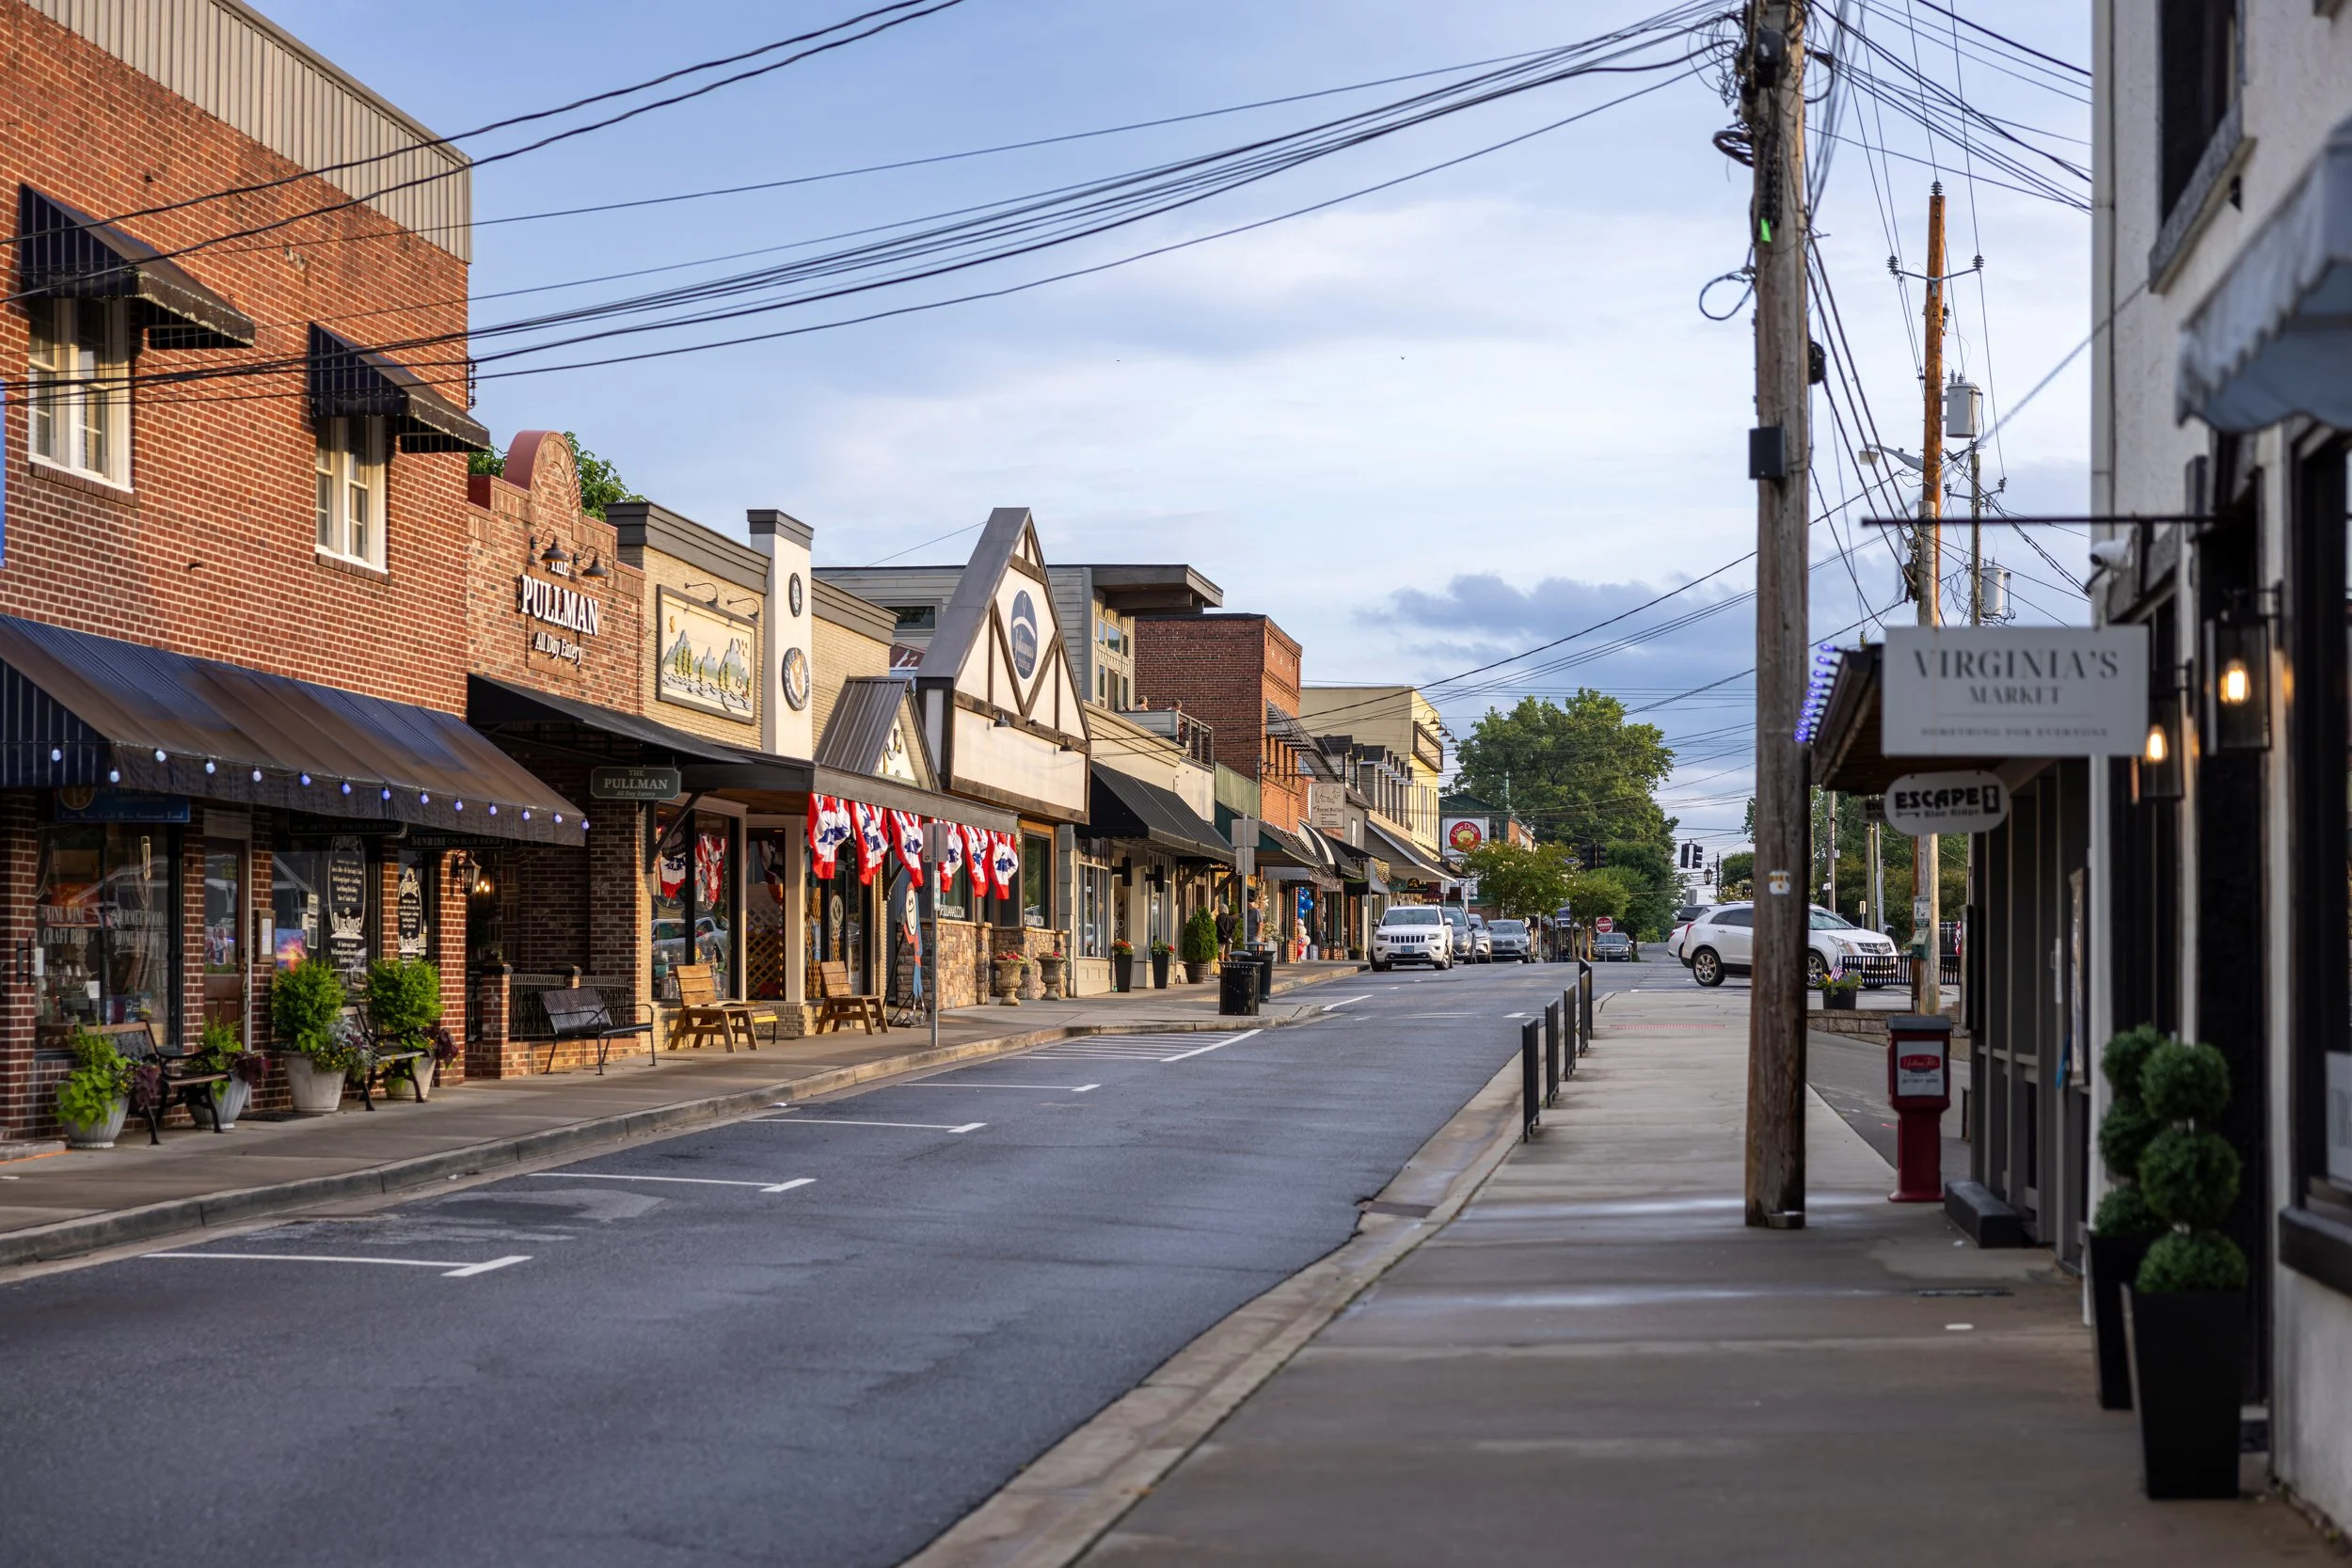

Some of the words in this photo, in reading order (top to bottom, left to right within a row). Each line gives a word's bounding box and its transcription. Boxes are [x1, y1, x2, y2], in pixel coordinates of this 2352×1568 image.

[521, 575, 599, 636] PULLMAN
[535, 632, 547, 651] All
[547, 635, 561, 659] Day
[561, 639, 582, 665] Eatery
[1914, 649, 2119, 679] VIRGINIA'S
[1969, 686, 2062, 705] MARKET
[603, 778, 669, 789] PULLMAN
[1895, 787, 1980, 809] ESCAPE
[1924, 810, 1947, 818] Blue
[1950, 809, 1980, 817] Ridge
[1451, 825, 1464, 837] Love
[1464, 823, 1479, 833] Dogs
[411, 834, 448, 847] SUNRISE
[46, 906, 64, 922] FINE
[43, 927, 69, 944] CRAFT
